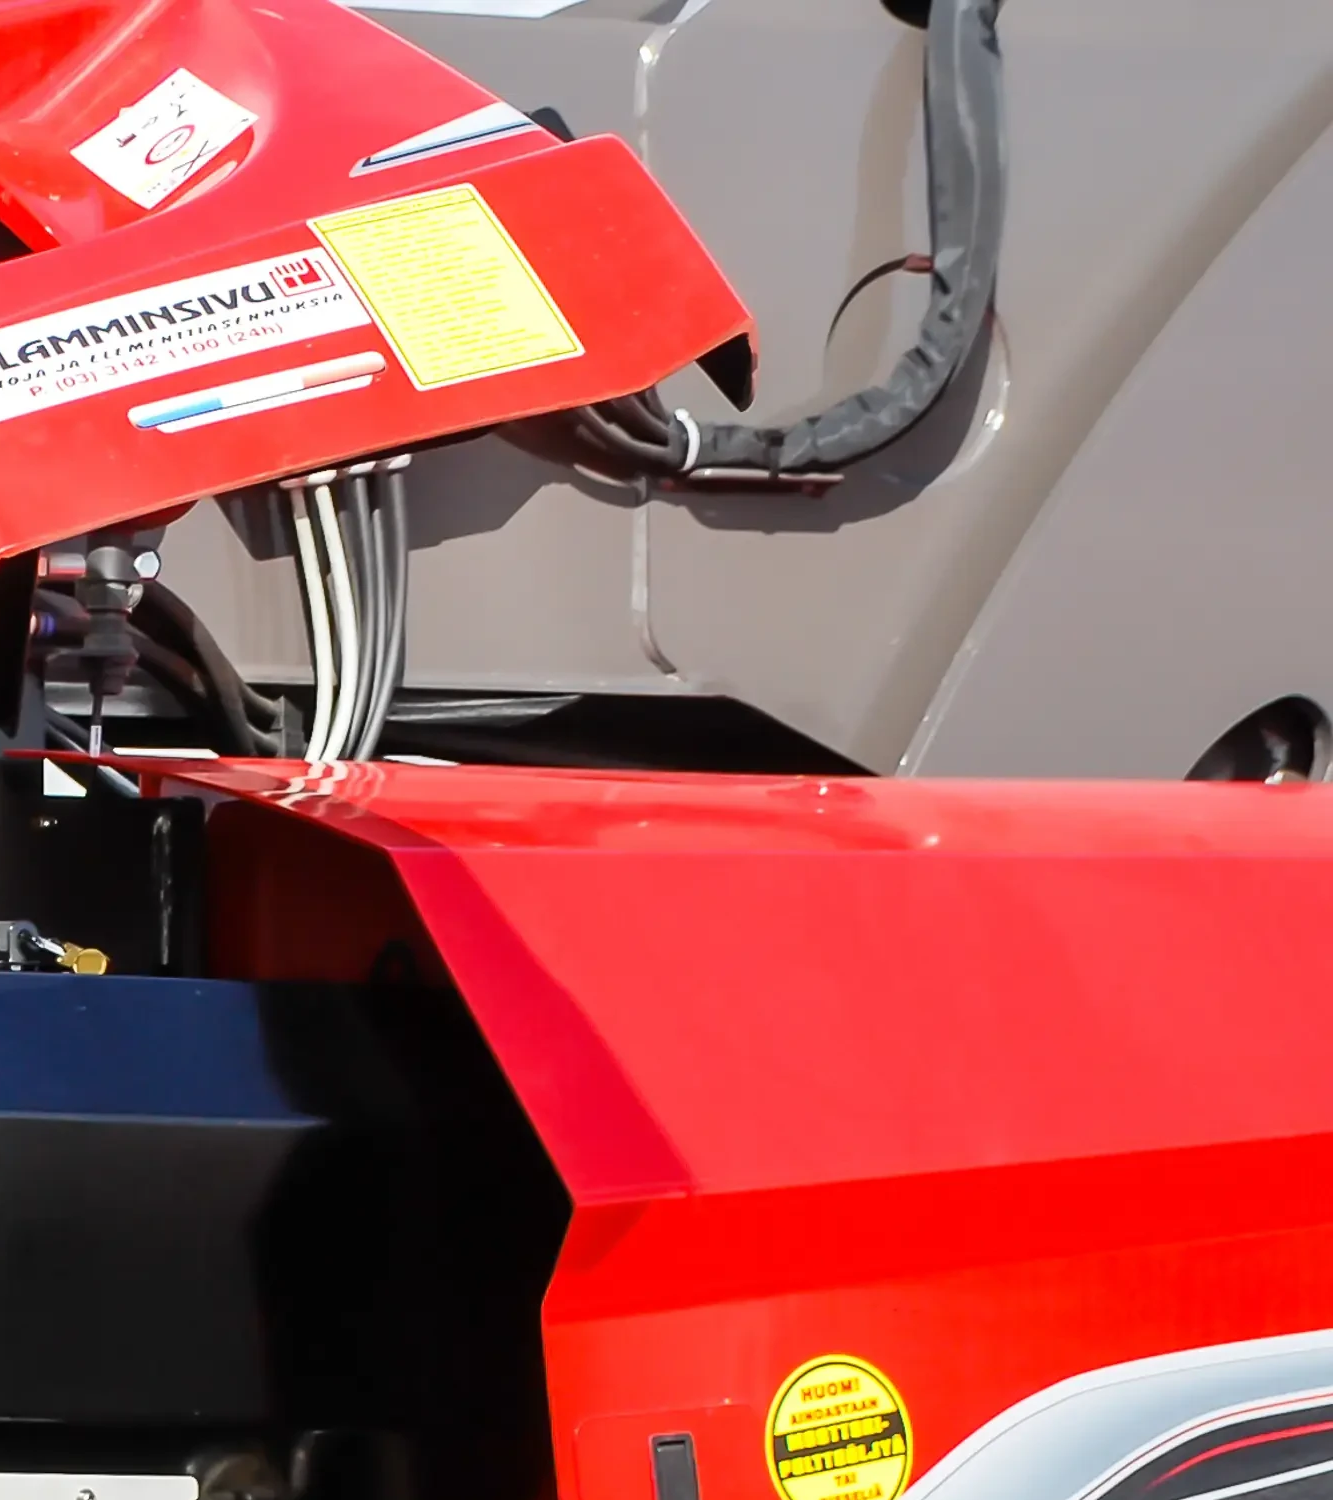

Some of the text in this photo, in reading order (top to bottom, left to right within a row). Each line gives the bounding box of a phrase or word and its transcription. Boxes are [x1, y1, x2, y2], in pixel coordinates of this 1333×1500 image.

[55, 368, 99, 393] (03)
[106, 353, 159, 377] 3142
[168, 336, 219, 361] 1100
[227, 321, 285, 348] (24h)
[55, 359, 80, 376] JA
[790, 1398, 879, 1425] AINOASTAAN
[833, 1472, 857, 1487] TAI
